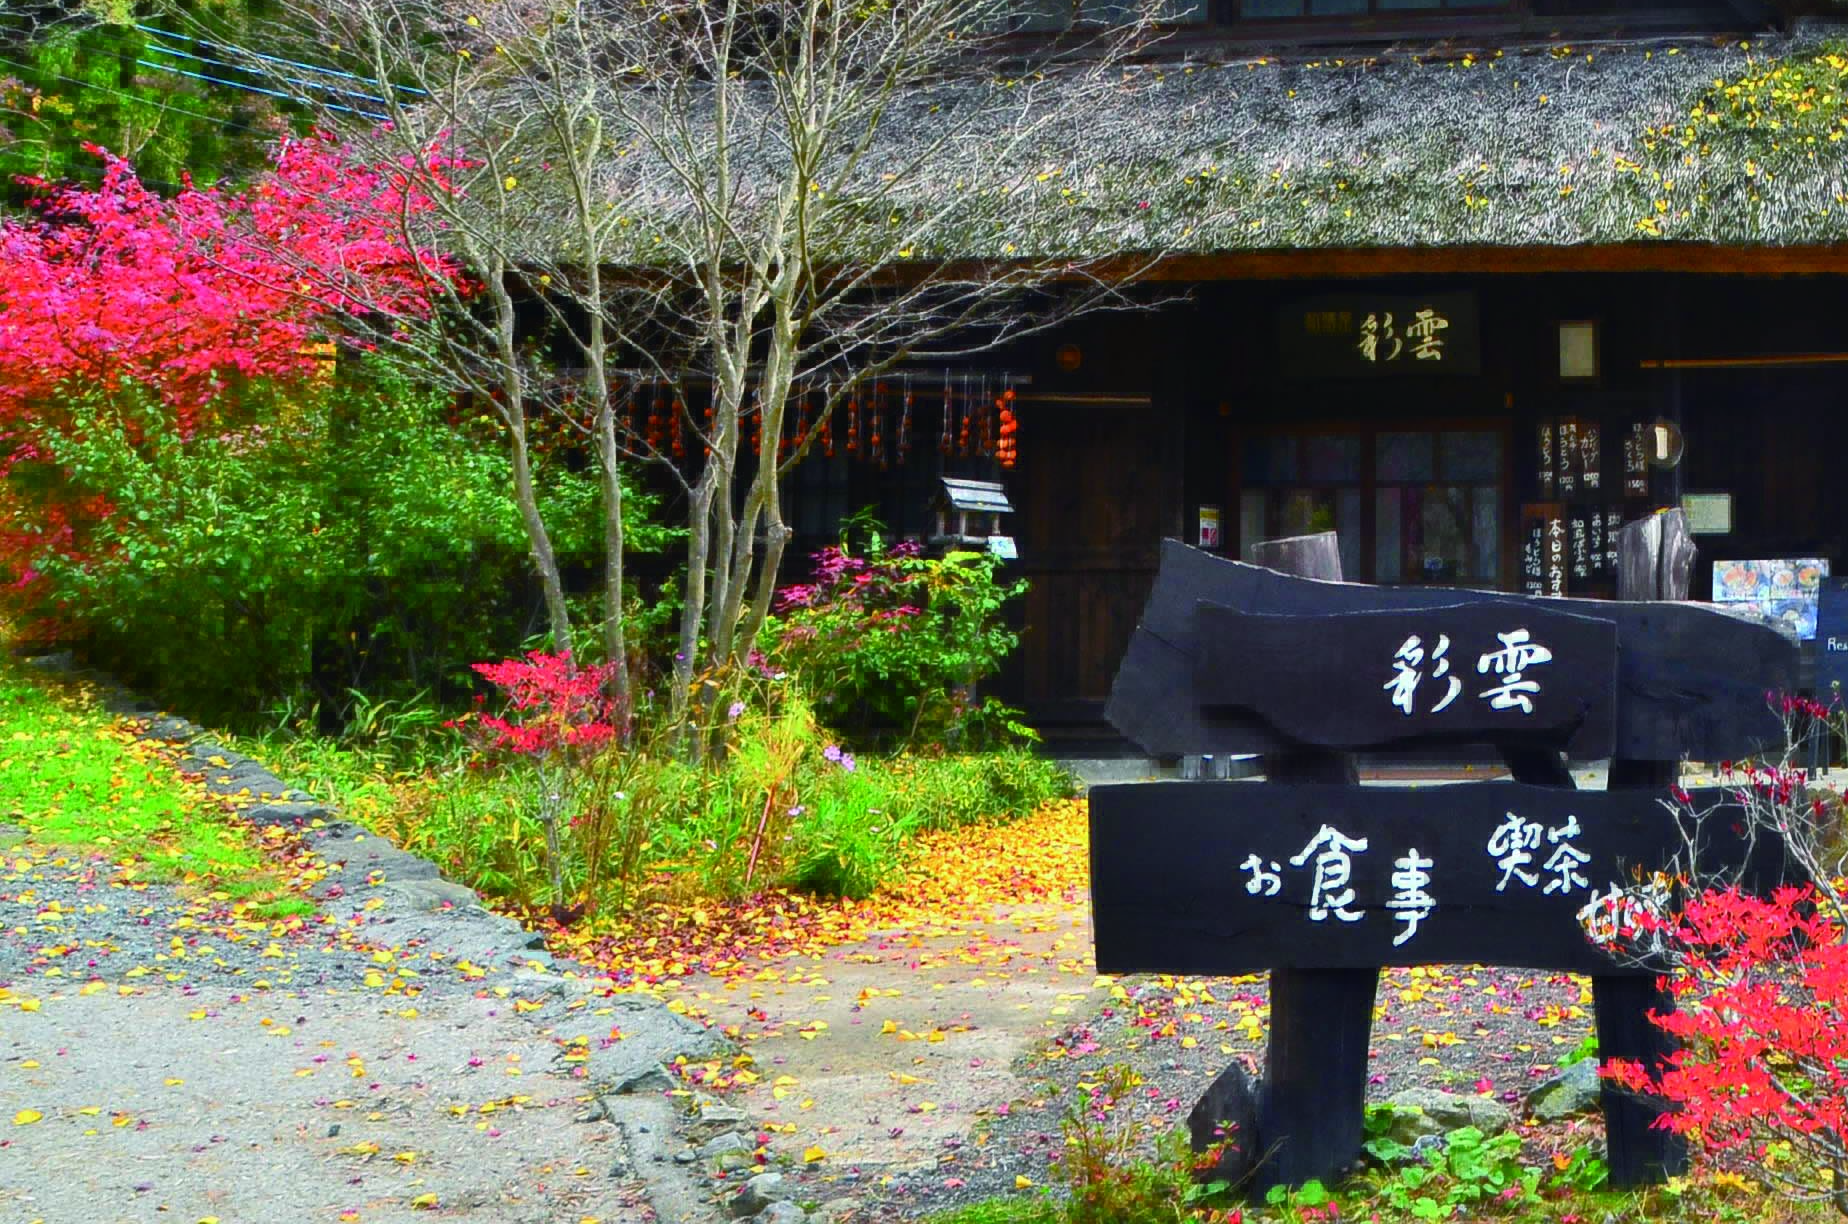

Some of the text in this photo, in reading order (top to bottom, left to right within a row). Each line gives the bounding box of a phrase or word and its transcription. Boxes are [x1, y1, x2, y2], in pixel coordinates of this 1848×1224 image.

[1357, 309, 1449, 362] 彩雲
[1559, 425, 1570, 470] ほうとう
[1383, 628, 1553, 716] 彩雲
[1239, 823, 1437, 947] お食事
[1488, 811, 1591, 895] 喫茶
